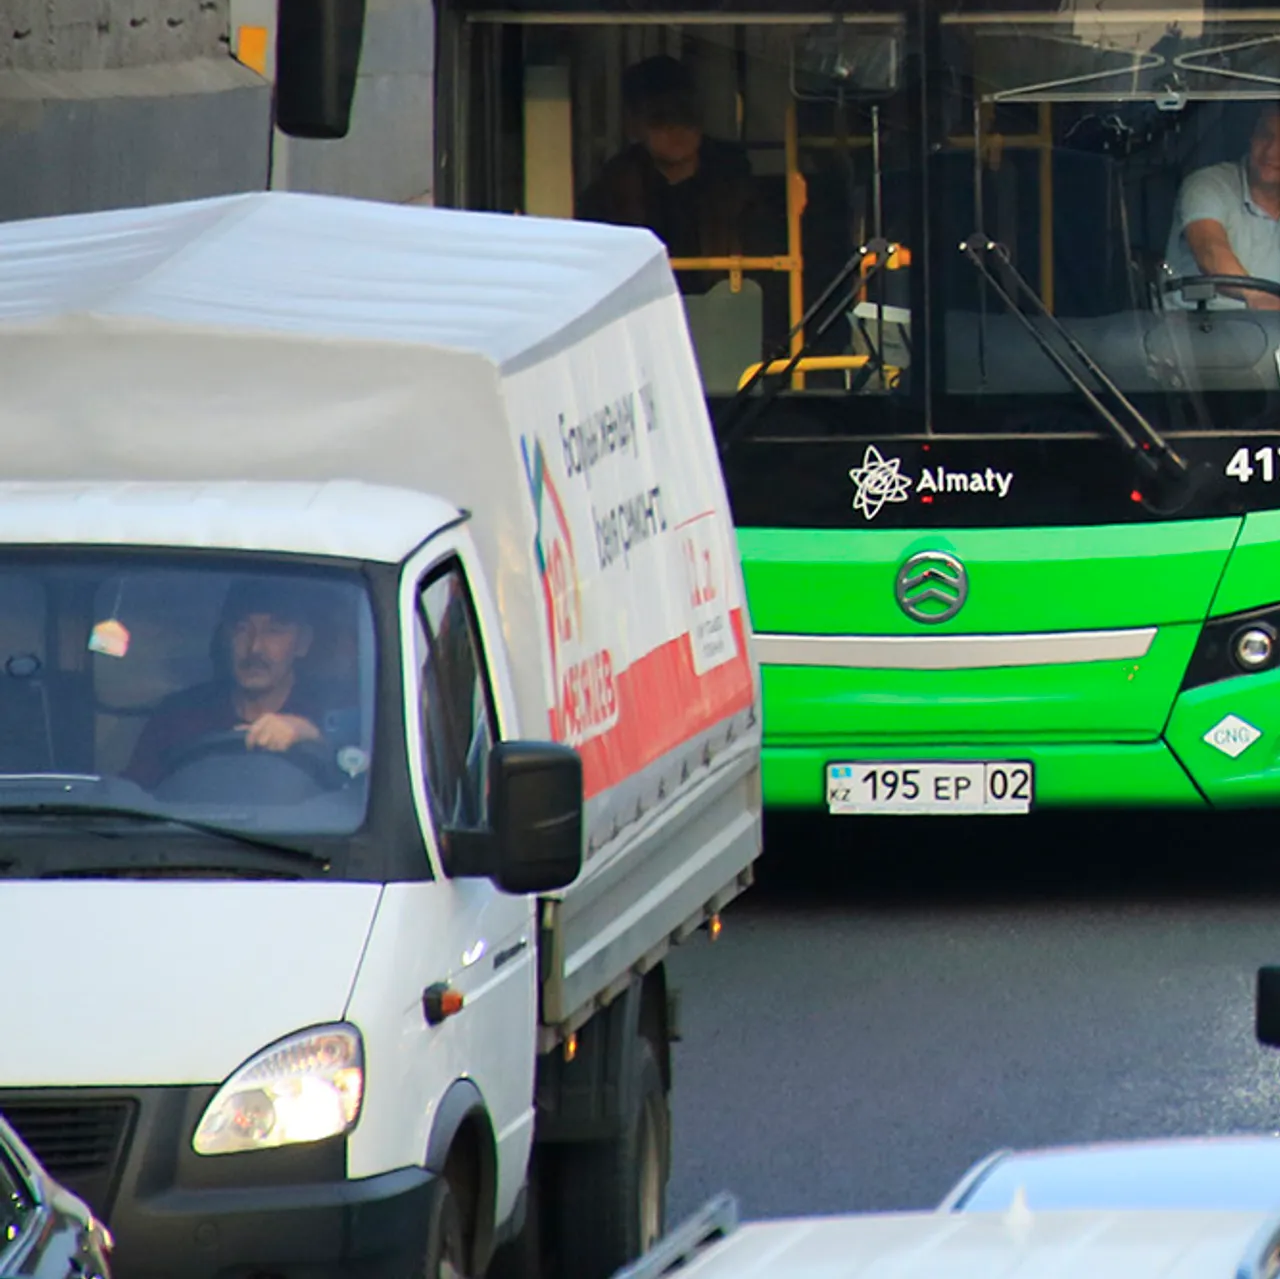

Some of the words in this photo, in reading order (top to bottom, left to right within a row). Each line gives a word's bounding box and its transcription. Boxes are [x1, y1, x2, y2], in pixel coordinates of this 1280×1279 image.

[915, 465, 1014, 498] Almaty
[1213, 725, 1251, 746] CNG
[829, 789, 851, 802] KZ
[862, 768, 920, 801] 195
[933, 776, 971, 801] EP
[990, 768, 1029, 800] 02
